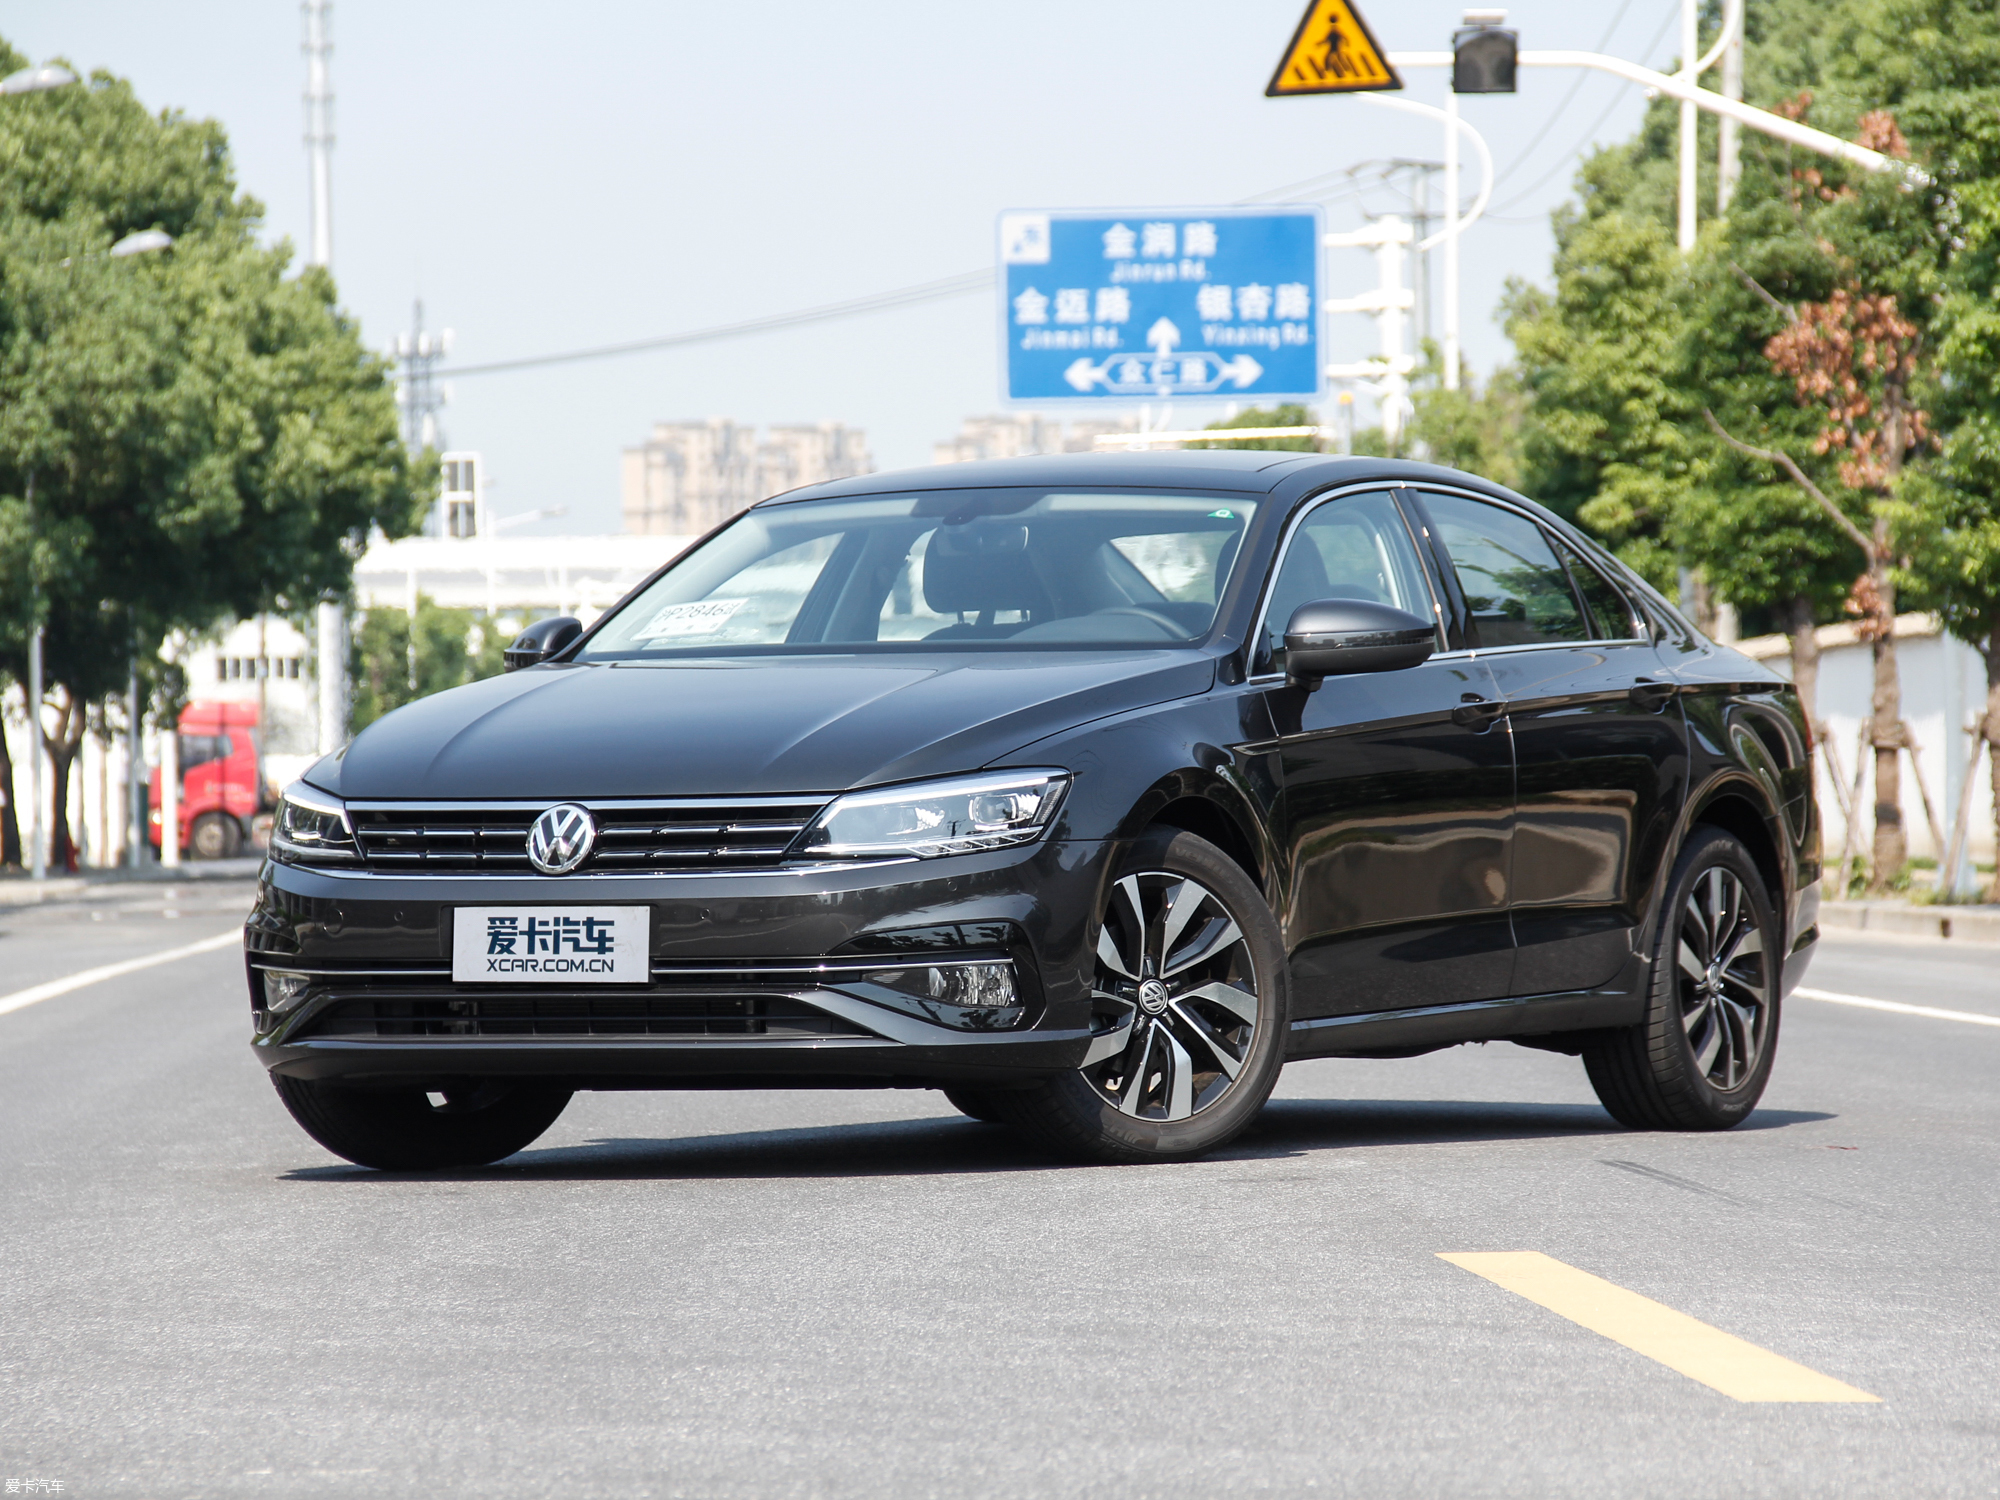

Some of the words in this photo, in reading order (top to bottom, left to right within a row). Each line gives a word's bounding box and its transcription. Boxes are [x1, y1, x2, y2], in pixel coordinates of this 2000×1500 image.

[1196, 282, 1311, 321] 银杏路
[1201, 322, 1280, 351] Yinxing
[487, 917, 615, 955] 爱卡汽车
[487, 959, 615, 973] XCAR.COM.CN
